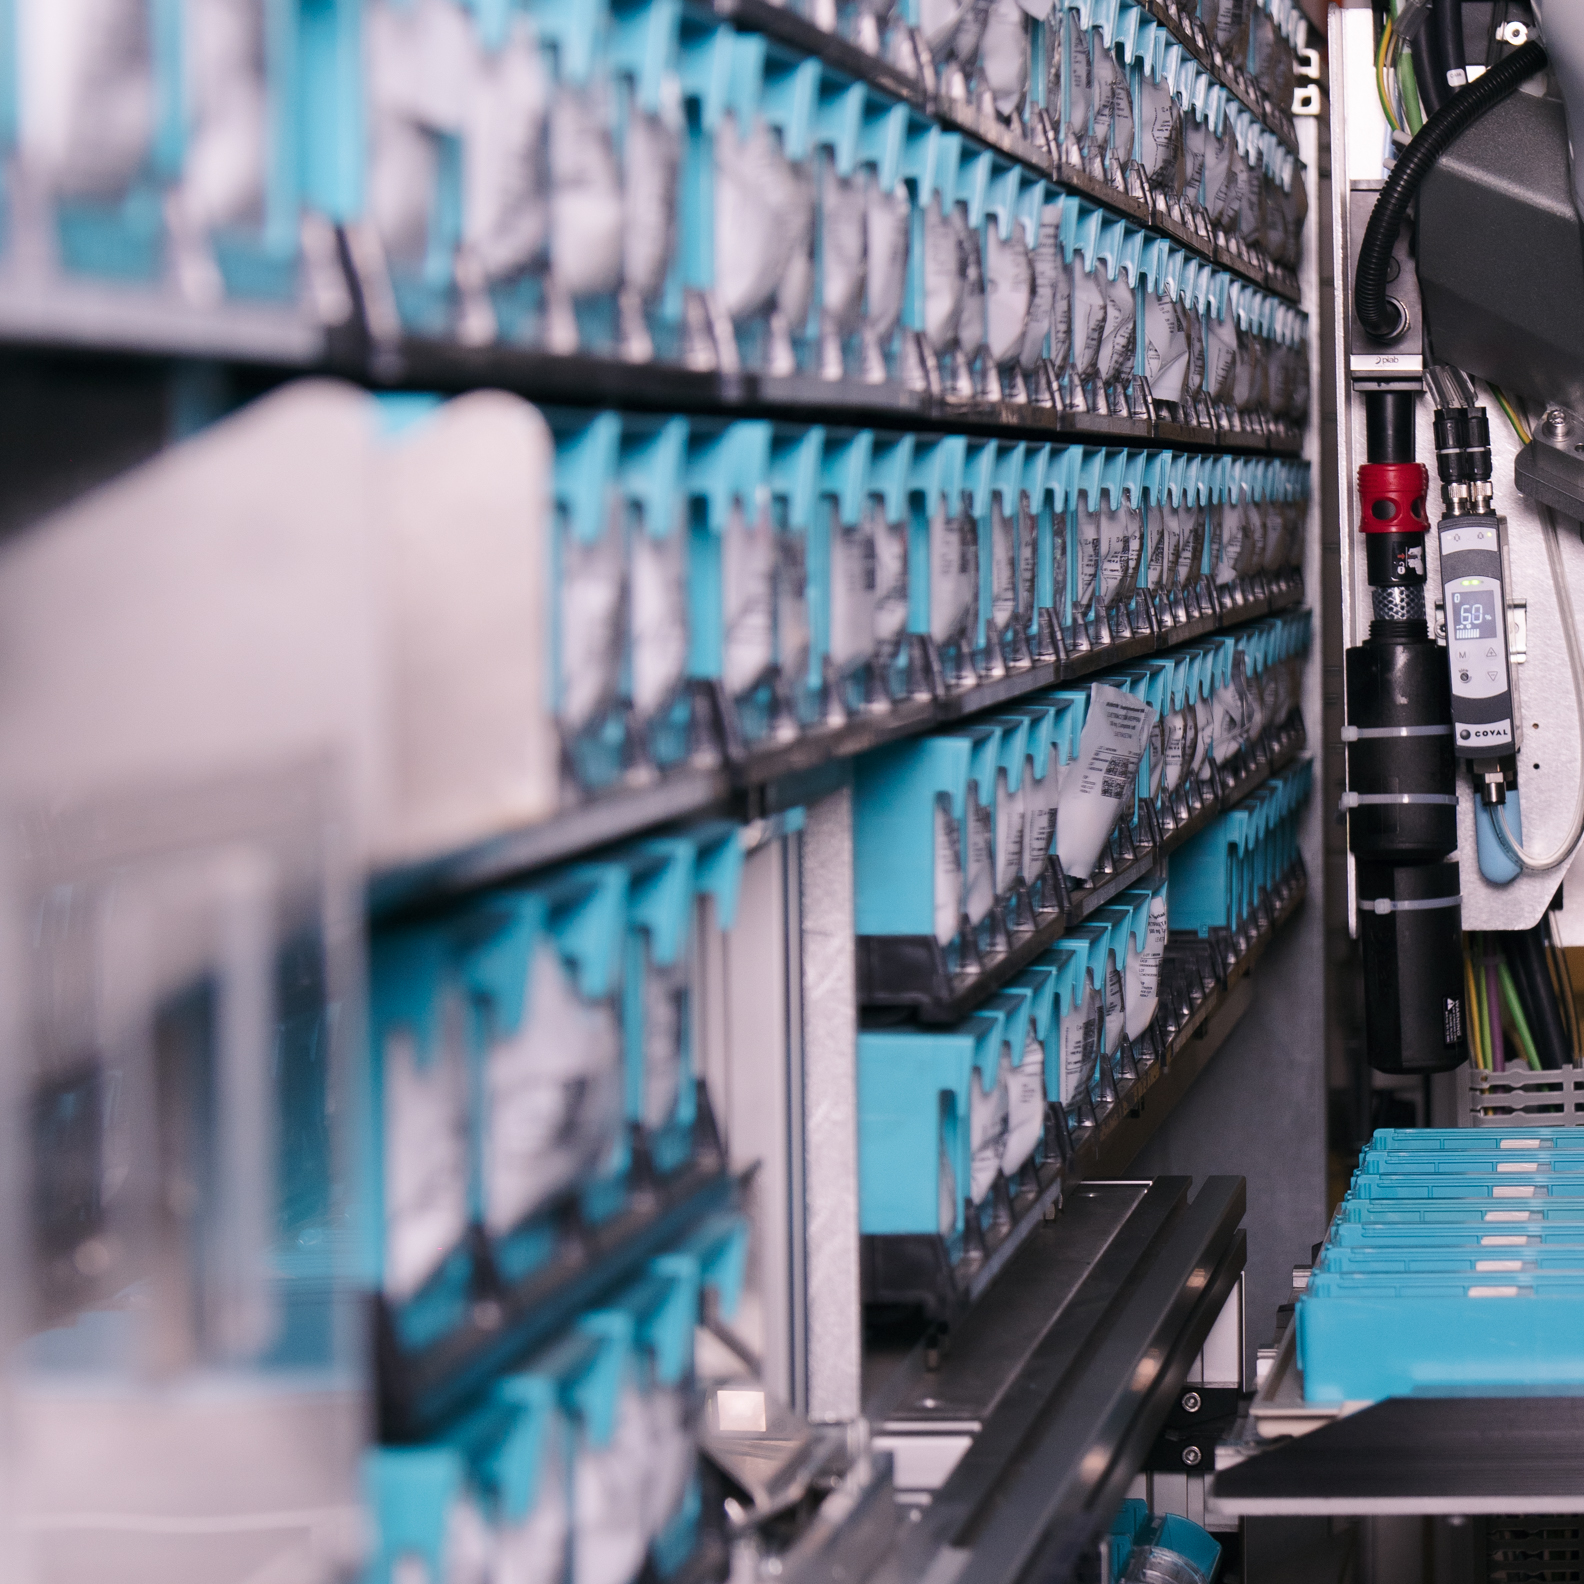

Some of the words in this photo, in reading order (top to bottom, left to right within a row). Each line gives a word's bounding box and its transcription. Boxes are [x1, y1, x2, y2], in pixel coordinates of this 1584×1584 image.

[1461, 603, 1483, 624] 60
[1459, 651, 1467, 659] M
[1474, 729, 1509, 737] COVAL
